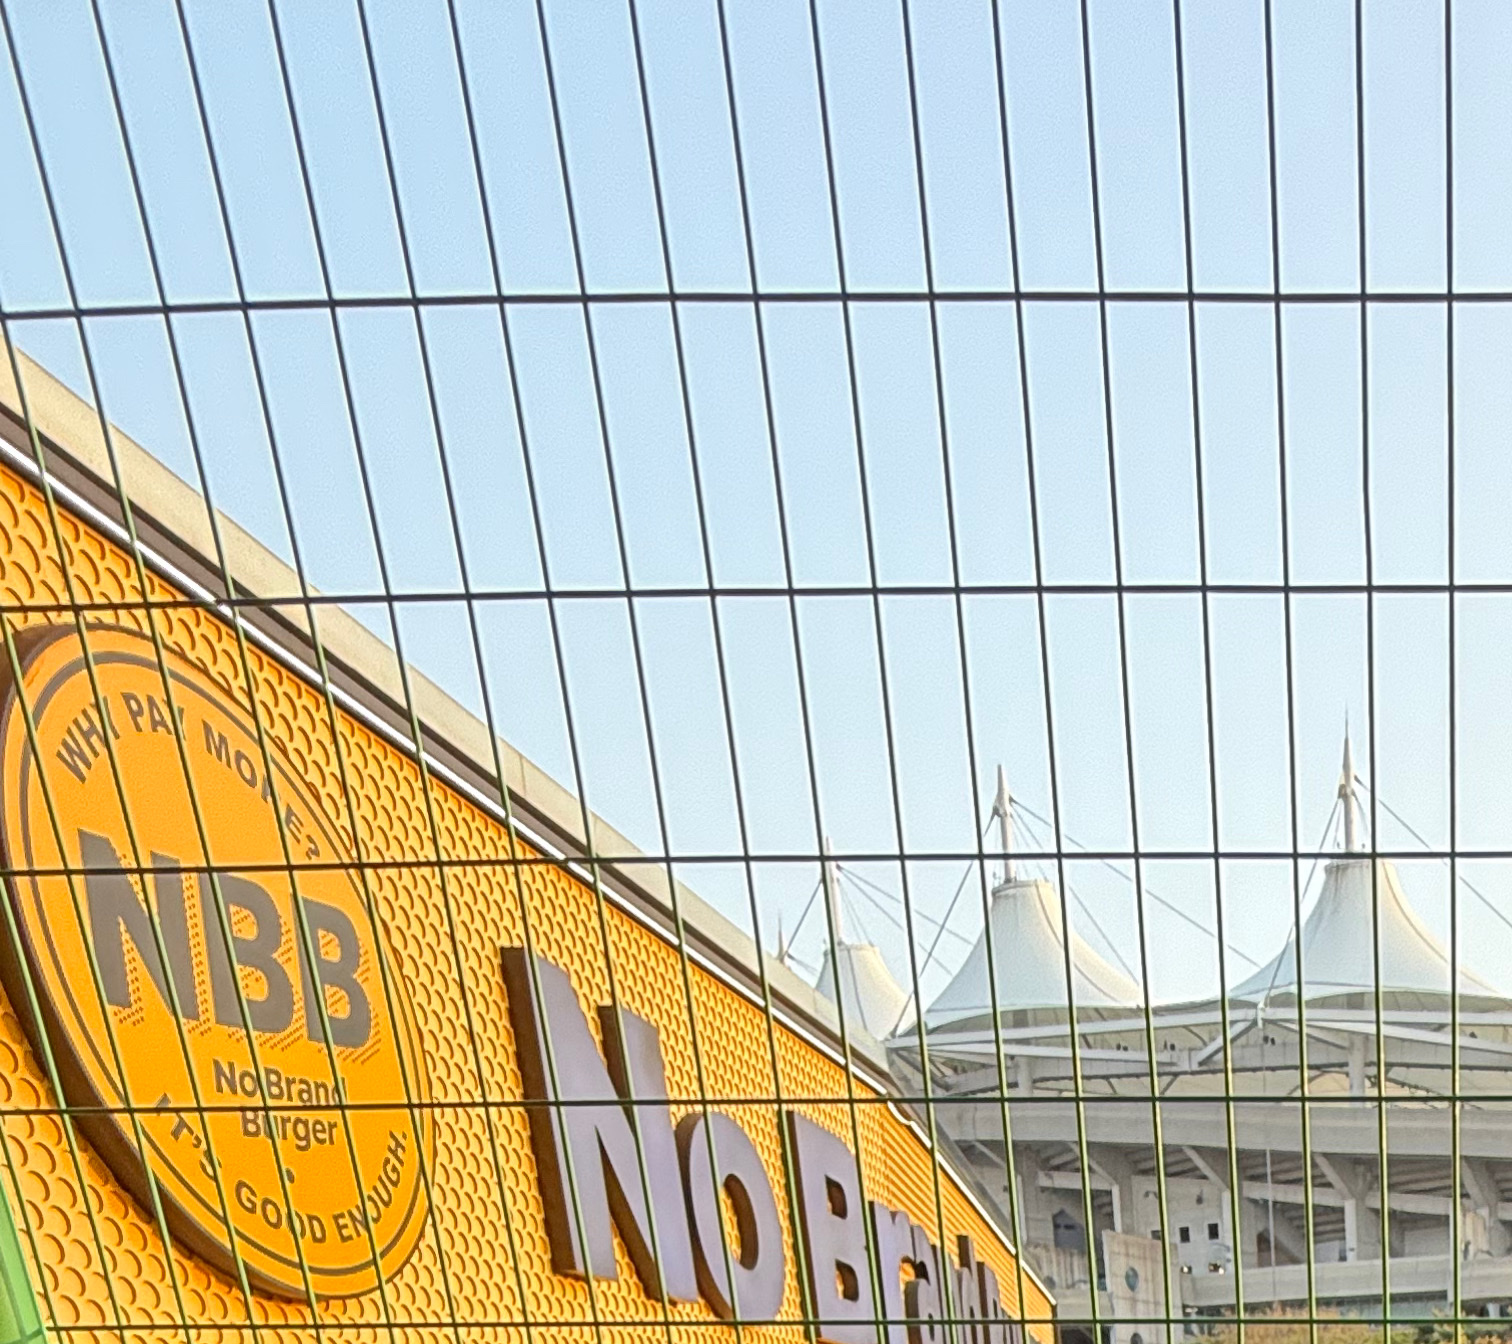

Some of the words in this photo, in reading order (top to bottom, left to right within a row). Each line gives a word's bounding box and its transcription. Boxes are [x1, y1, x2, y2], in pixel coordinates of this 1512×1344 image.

[56, 695, 120, 784] WHY
[77, 827, 372, 1049] NBB
[240, 1106, 337, 1151] Burger
[234, 1180, 327, 1244] GOOD
